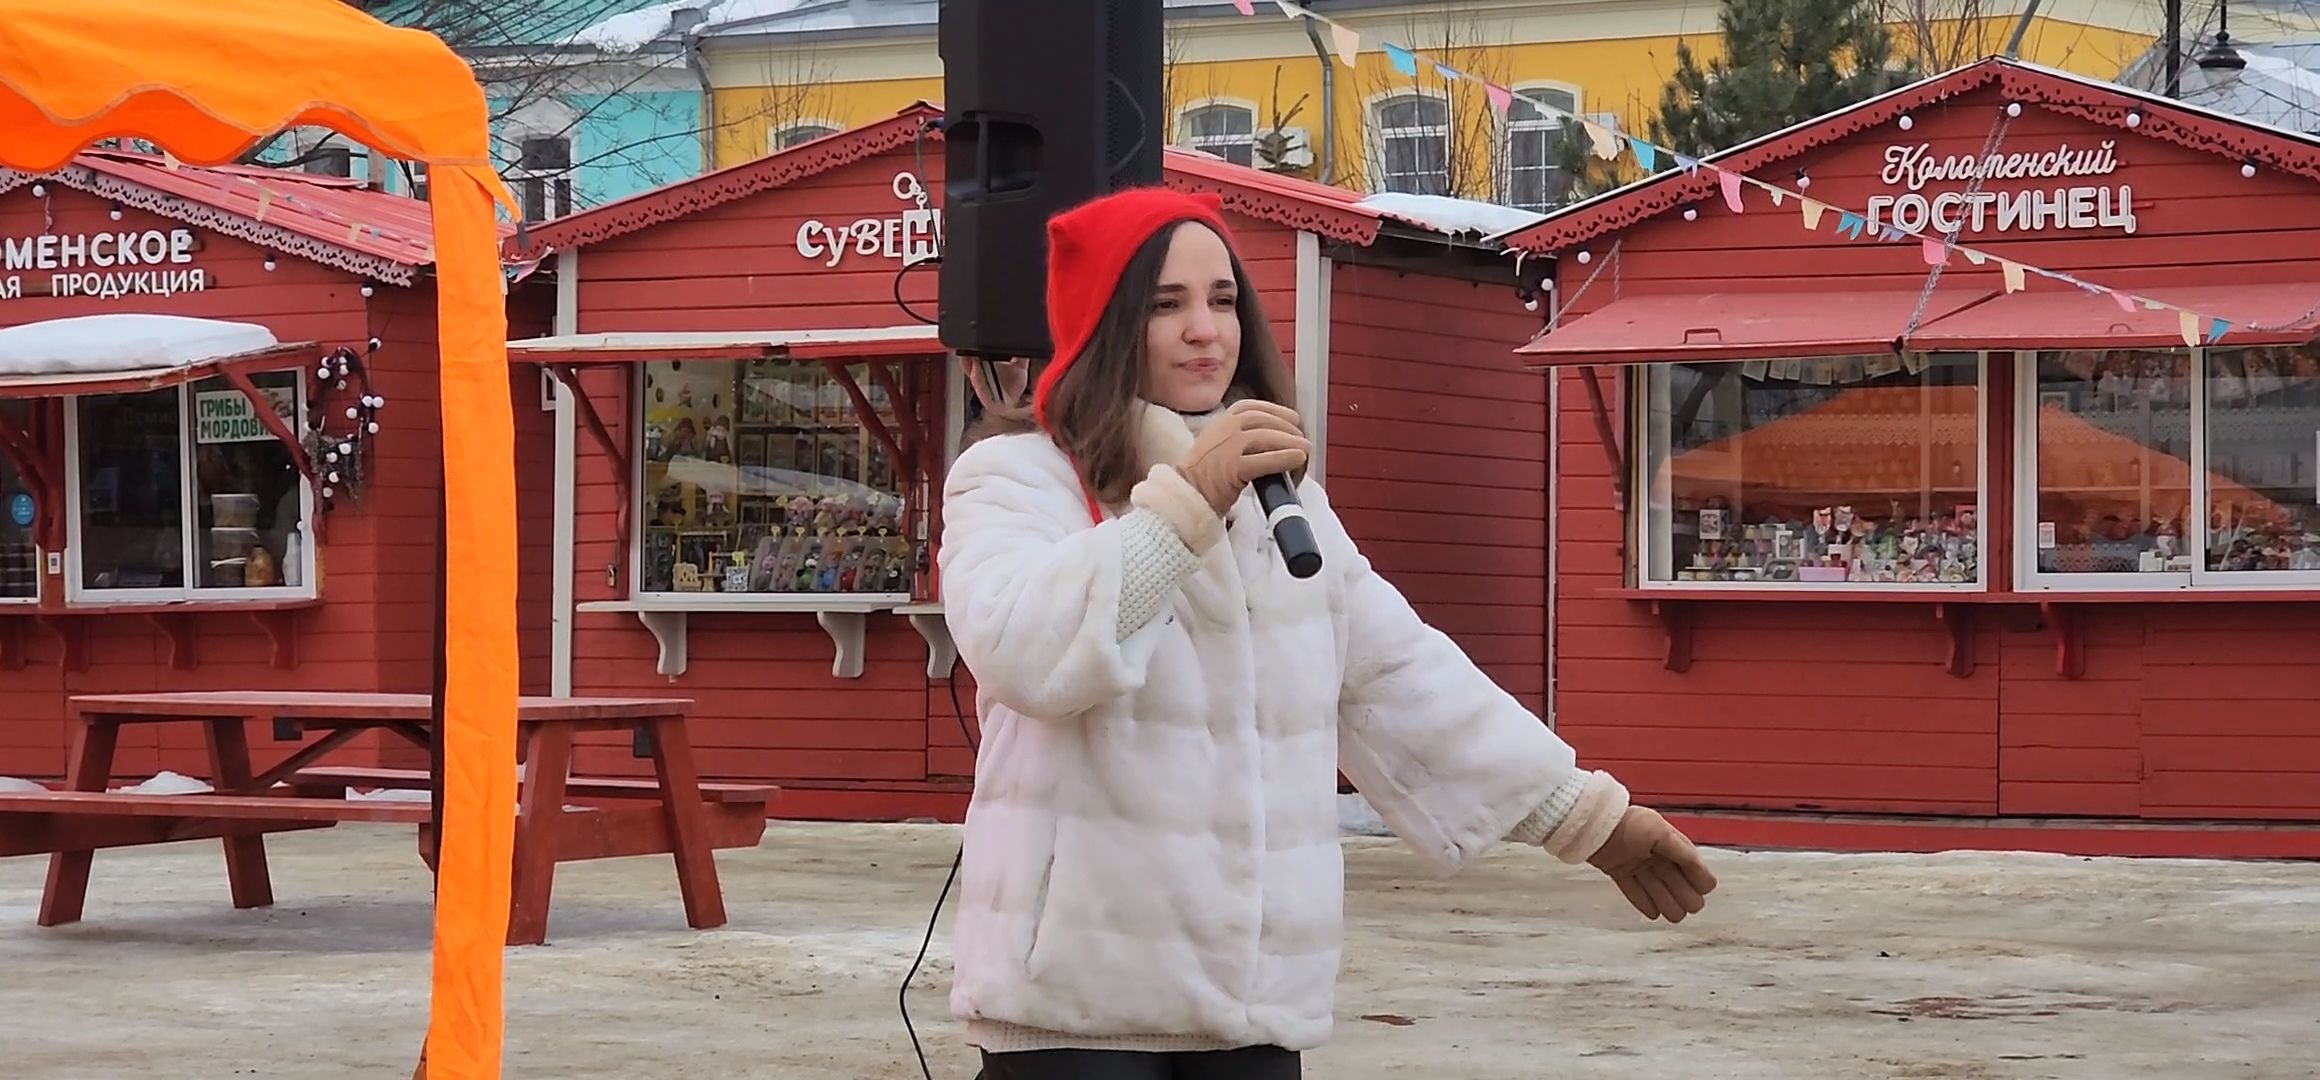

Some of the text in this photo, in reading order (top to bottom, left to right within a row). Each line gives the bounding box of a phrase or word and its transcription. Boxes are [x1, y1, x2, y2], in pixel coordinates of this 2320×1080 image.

[1881, 139, 2118, 191] Коломенский
[1866, 185, 2137, 235] ГОСТИНЕЦ
[0, 228, 193, 270] МЕНСКОЕ
[796, 209, 946, 268] СуВЕН
[52, 268, 205, 299] ПРОДУКЦИЯ
[199, 397, 246, 418] ГРИБЫ
[200, 417, 270, 440] МОРДОВИ
